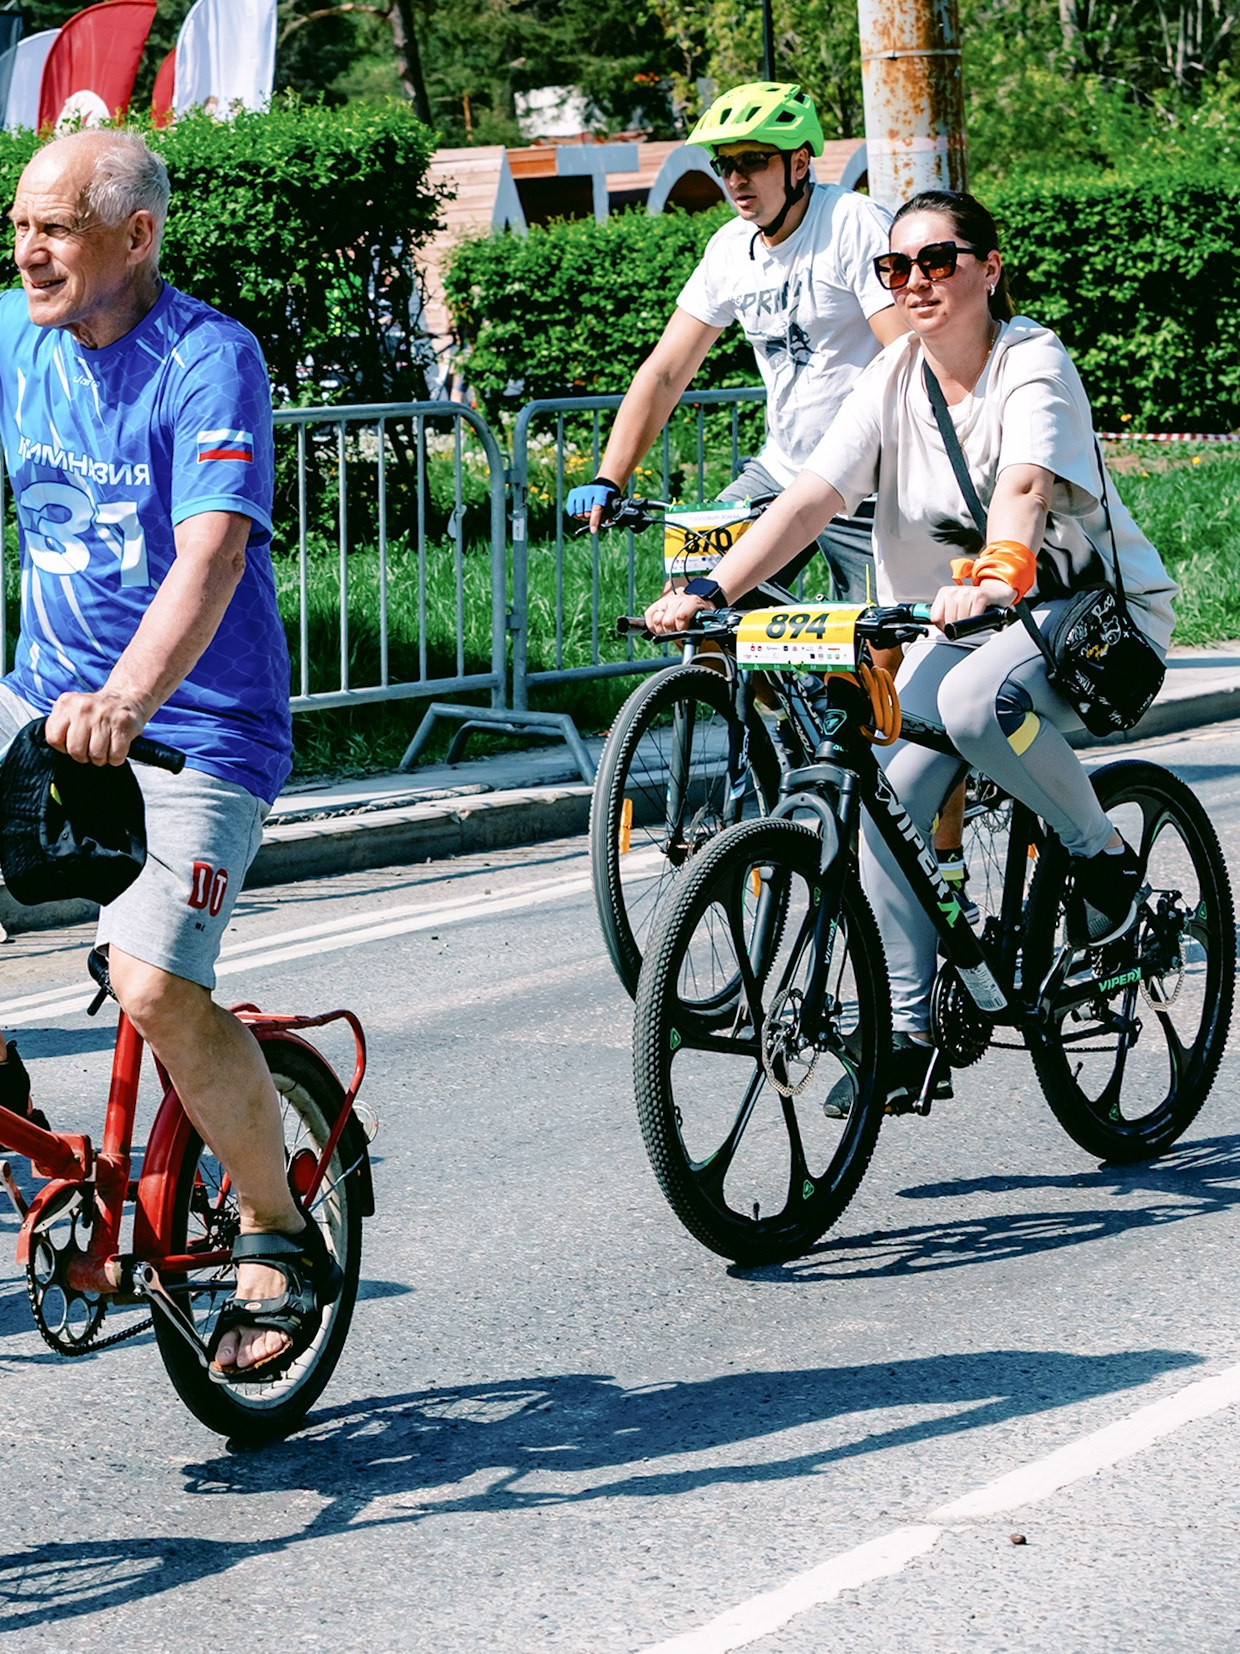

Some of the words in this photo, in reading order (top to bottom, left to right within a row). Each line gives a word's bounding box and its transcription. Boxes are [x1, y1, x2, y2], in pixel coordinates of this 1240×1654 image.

[20, 481, 151, 588] 31
[684, 527, 734, 553] 870
[766, 613, 830, 639] 894
[887, 802, 962, 929] VIPERX
[1098, 966, 1142, 992] VIPERX
